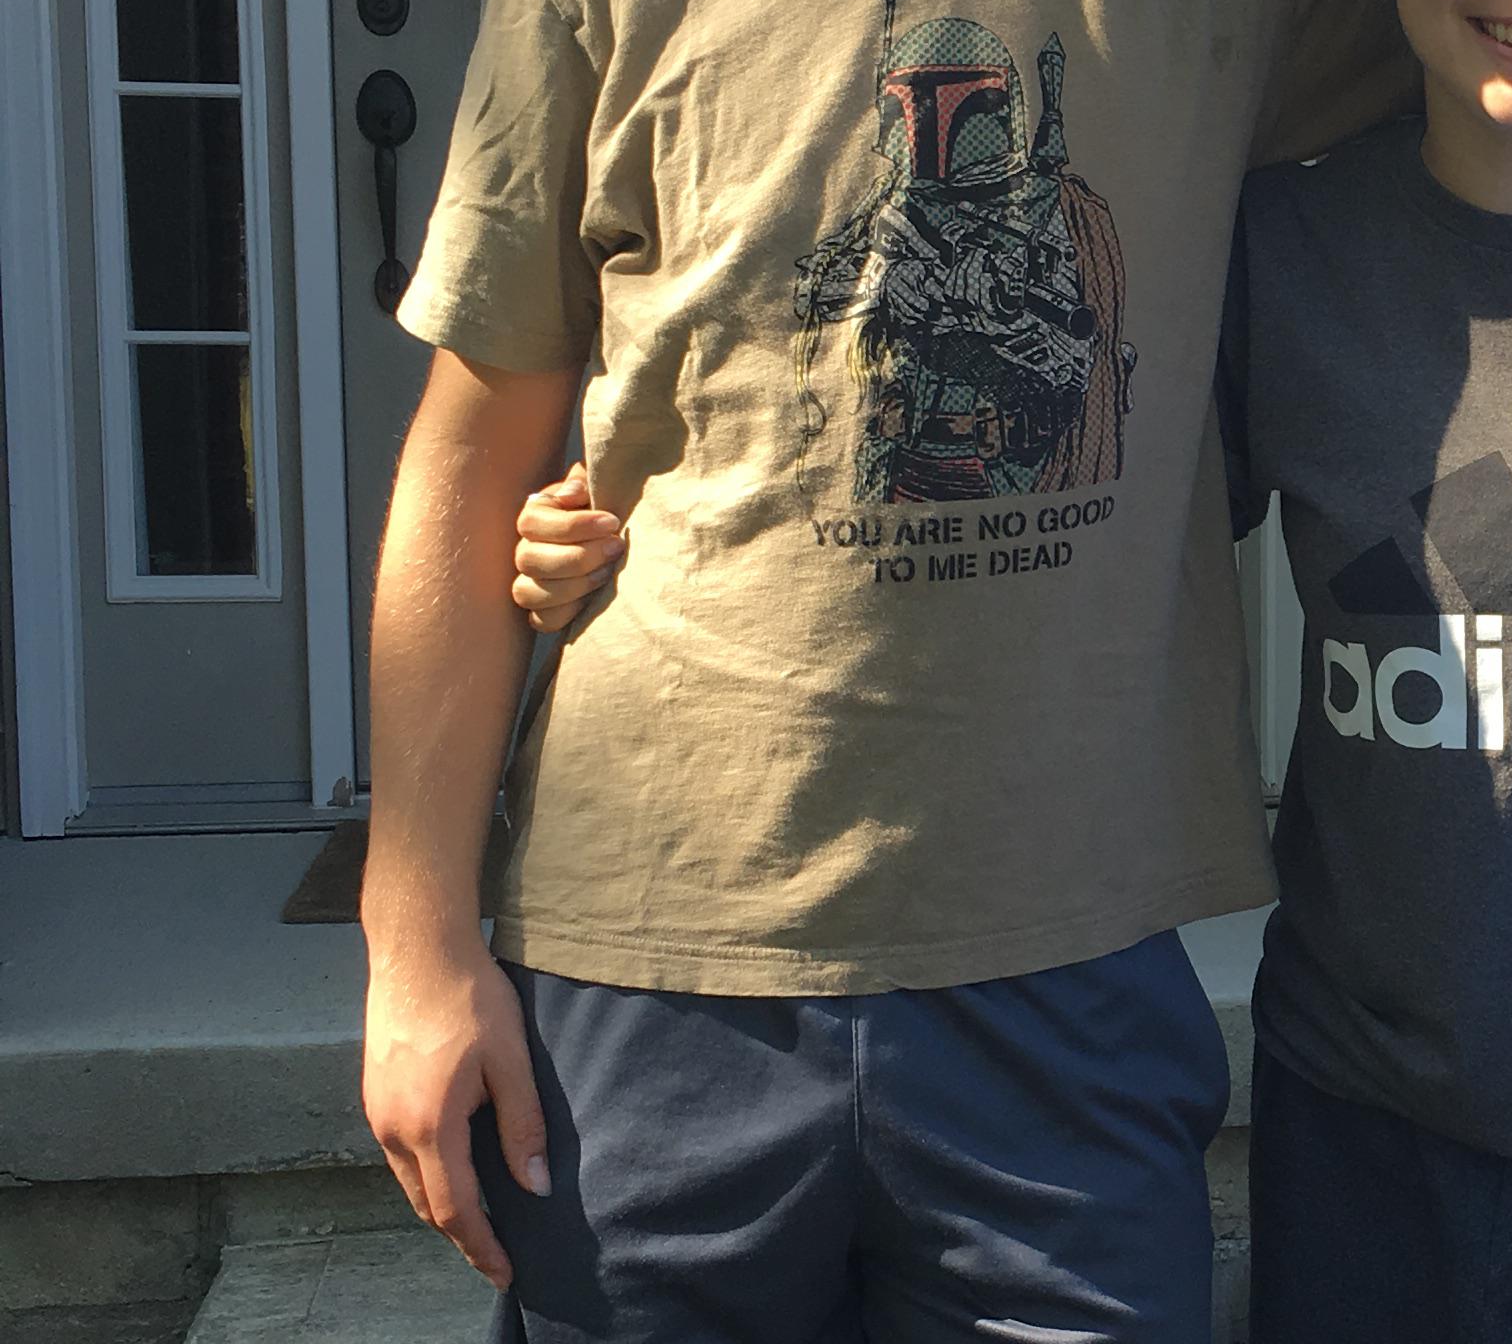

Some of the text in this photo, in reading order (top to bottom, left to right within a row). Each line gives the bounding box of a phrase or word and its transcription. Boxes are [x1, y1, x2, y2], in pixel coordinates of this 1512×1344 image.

[811, 496, 1116, 547] YOU ARE NO GOOD
[871, 541, 1074, 584] TO ME DEAD
